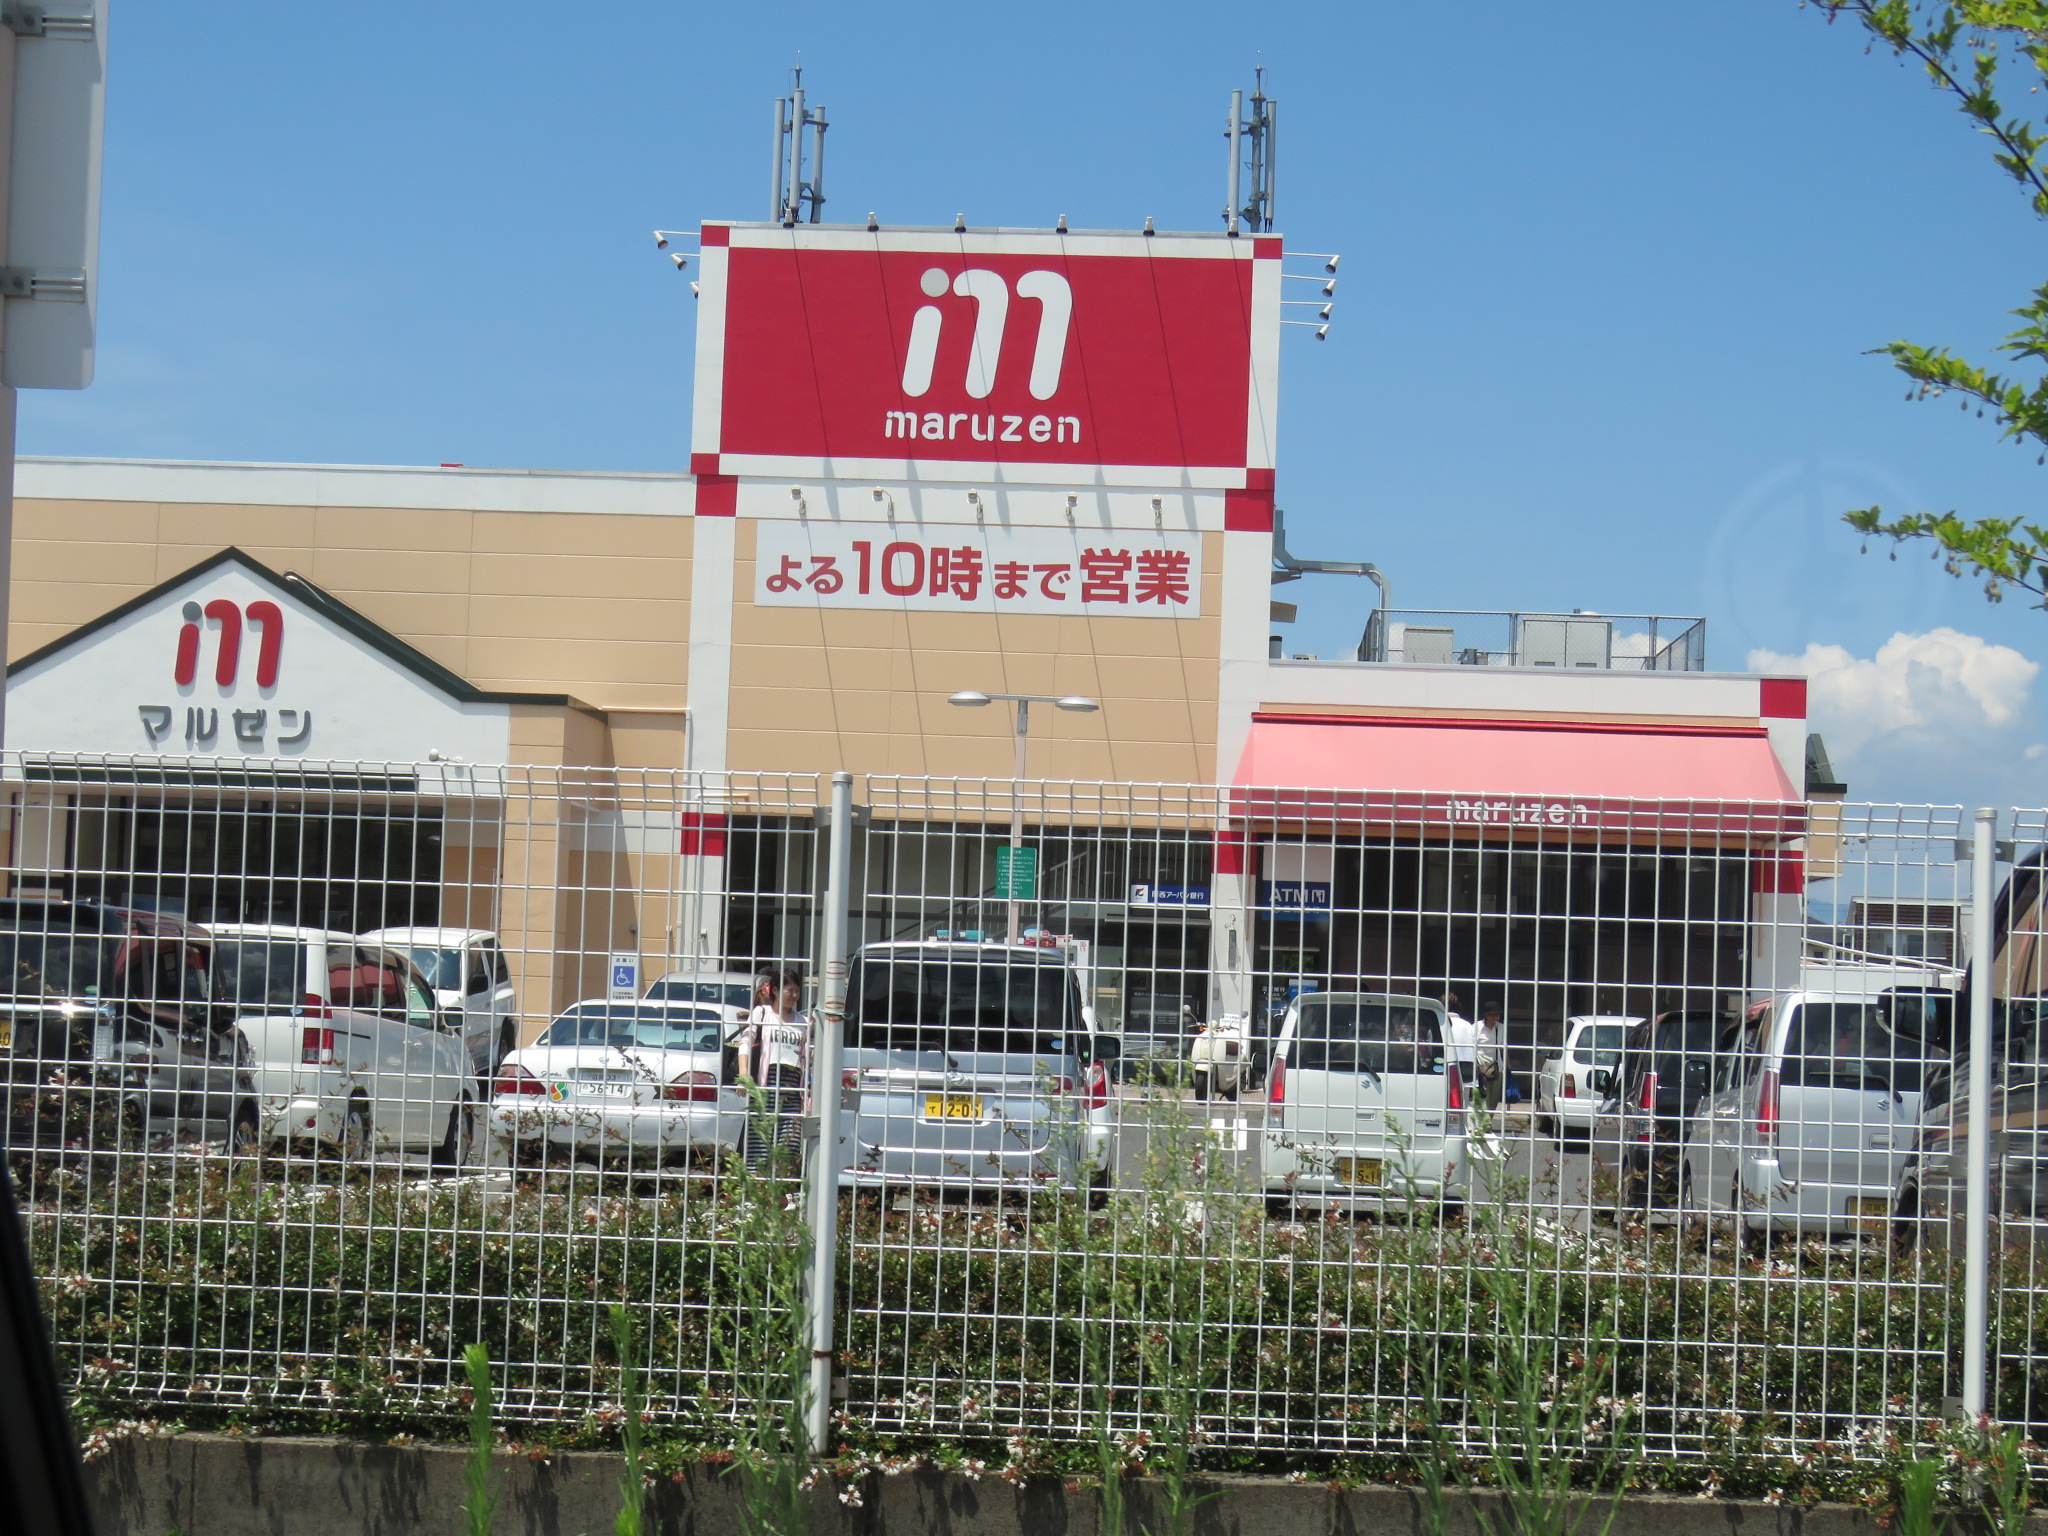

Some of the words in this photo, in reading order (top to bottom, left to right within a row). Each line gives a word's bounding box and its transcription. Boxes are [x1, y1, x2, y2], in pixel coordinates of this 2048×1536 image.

[884, 410, 1081, 444] maruzen
[765, 540, 1191, 605] よる10時まで営業
[138, 704, 312, 744] マルゼン
[1446, 799, 1588, 825] maruzen
[1269, 887, 1309, 903] ATM
